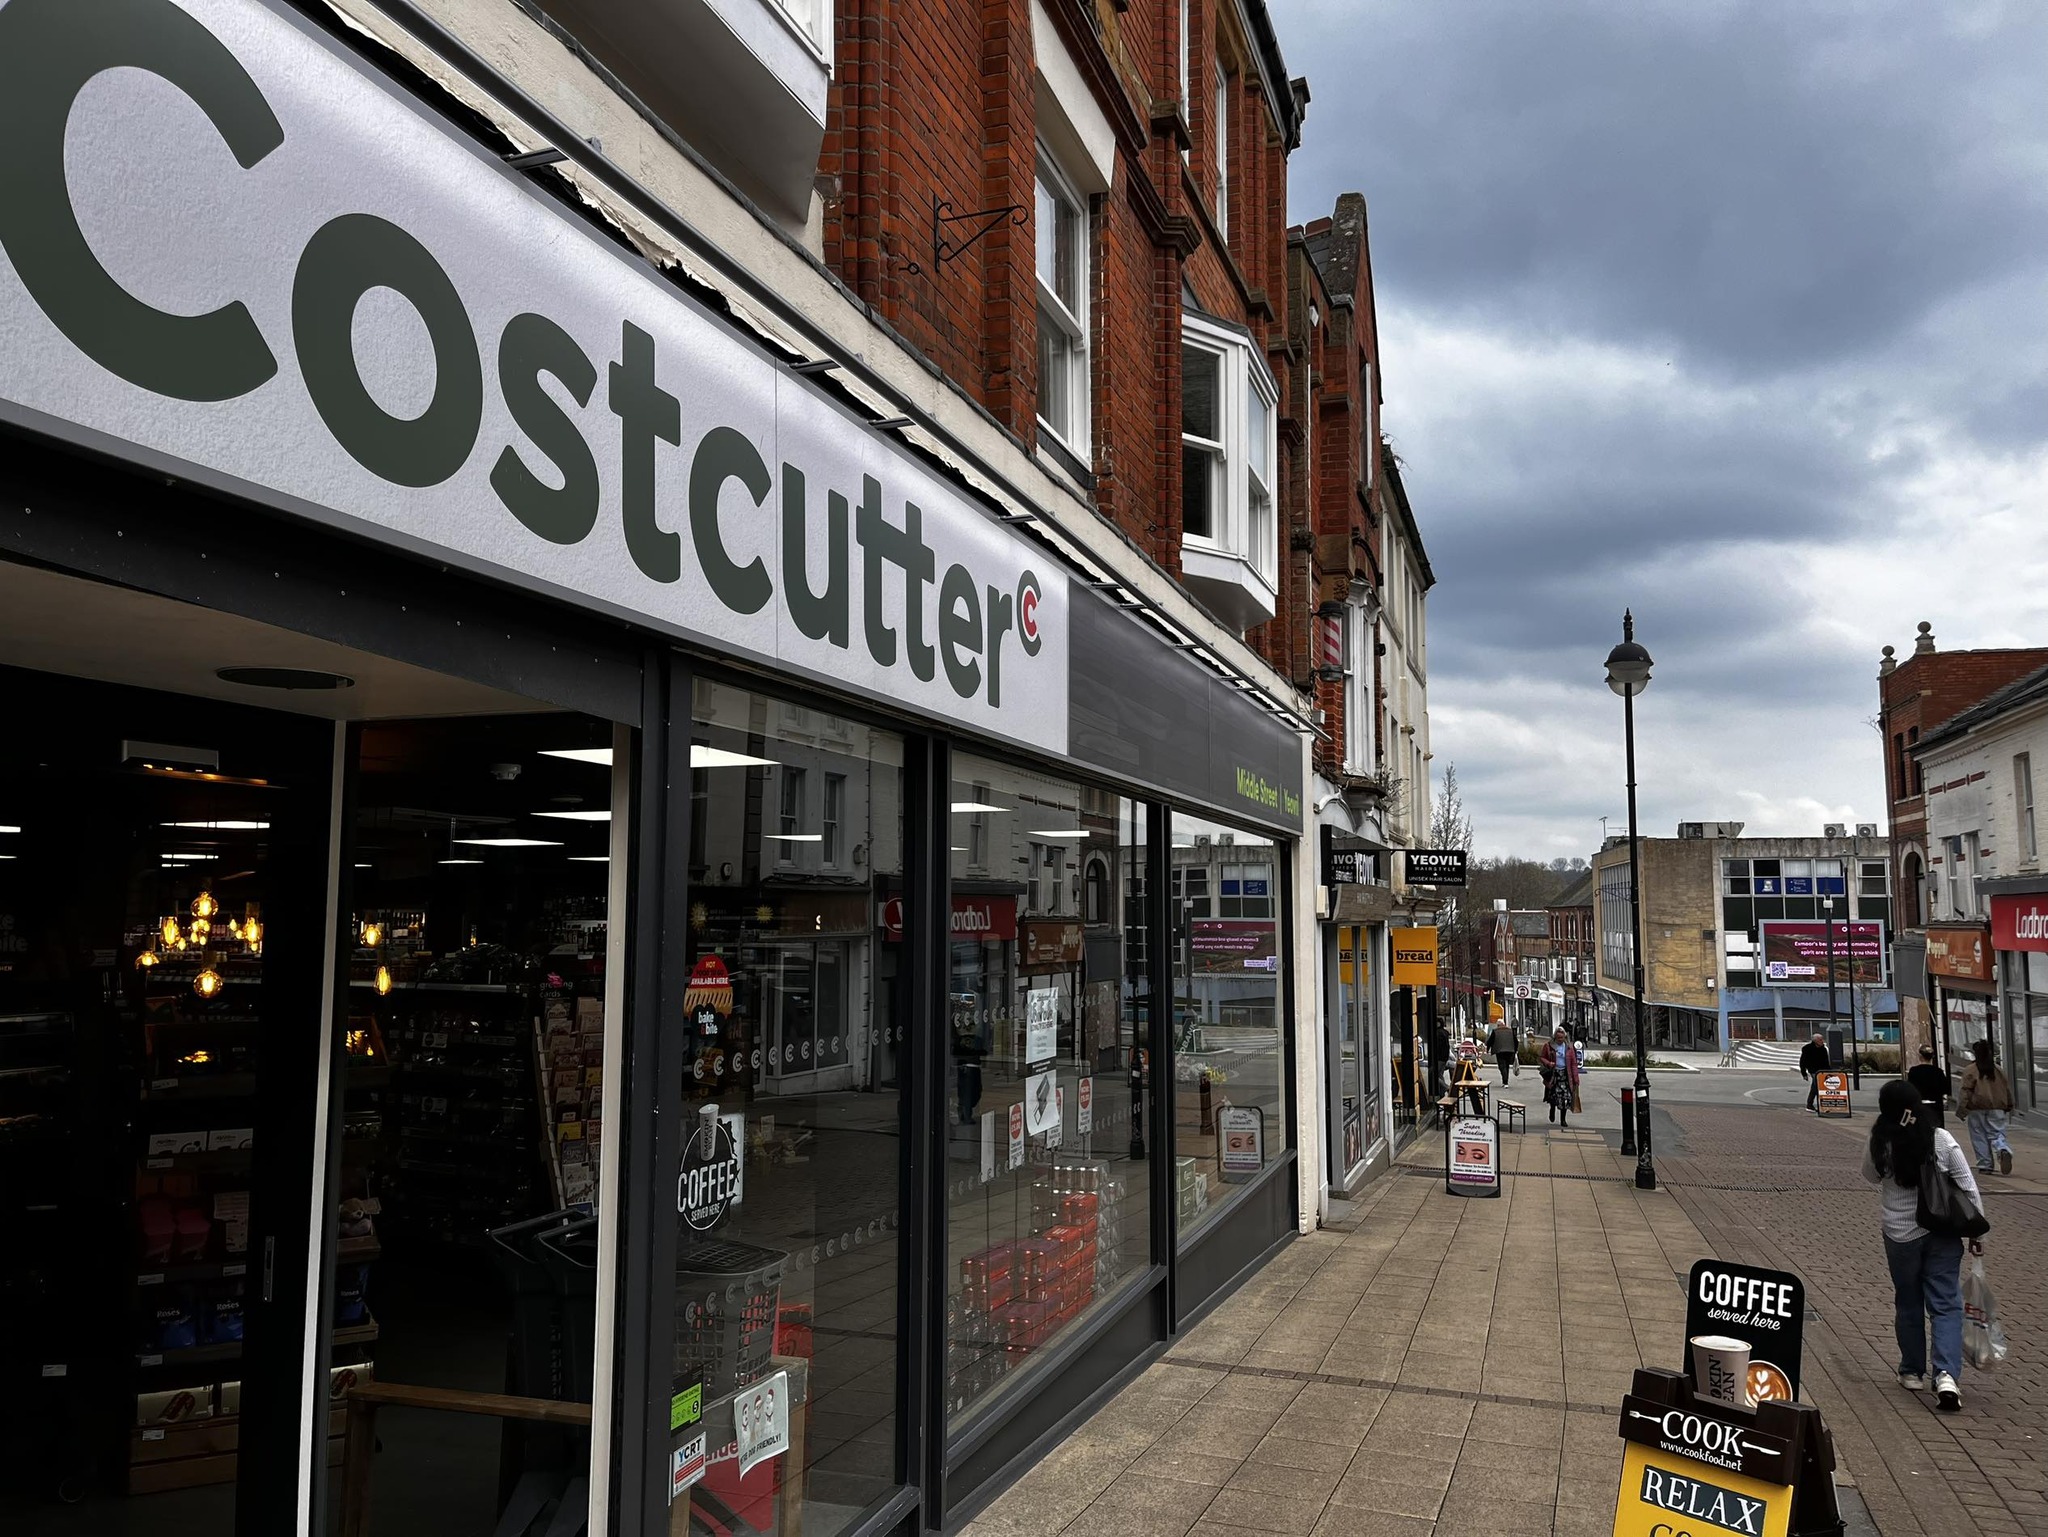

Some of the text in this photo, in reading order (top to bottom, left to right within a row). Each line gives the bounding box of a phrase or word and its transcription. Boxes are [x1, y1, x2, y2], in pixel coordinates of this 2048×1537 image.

[0, 0, 1012, 709] Costcutter
[1236, 766, 1278, 809] Middle Street
[1410, 854, 1462, 866] YEOVIL
[1396, 950, 1434, 962] bread
[690, 977, 729, 986] AVAILABLE HERE
[698, 1010, 714, 1024] bake
[705, 1022, 718, 1035] bite
[1458, 1128, 1486, 1138] Threading
[1463, 1122, 1481, 1130] Super
[677, 1158, 736, 1213] COFFEE
[690, 1202, 721, 1222] SERVED HERE
[1699, 1270, 1793, 1318] COFFEE
[1707, 1308, 1781, 1331] served here
[1662, 1410, 1745, 1458] COOK
[678, 1437, 702, 1463] YCRT
[1660, 1439, 1743, 1472] www.cookfood.net
[1642, 1468, 1762, 1536] RELAX
